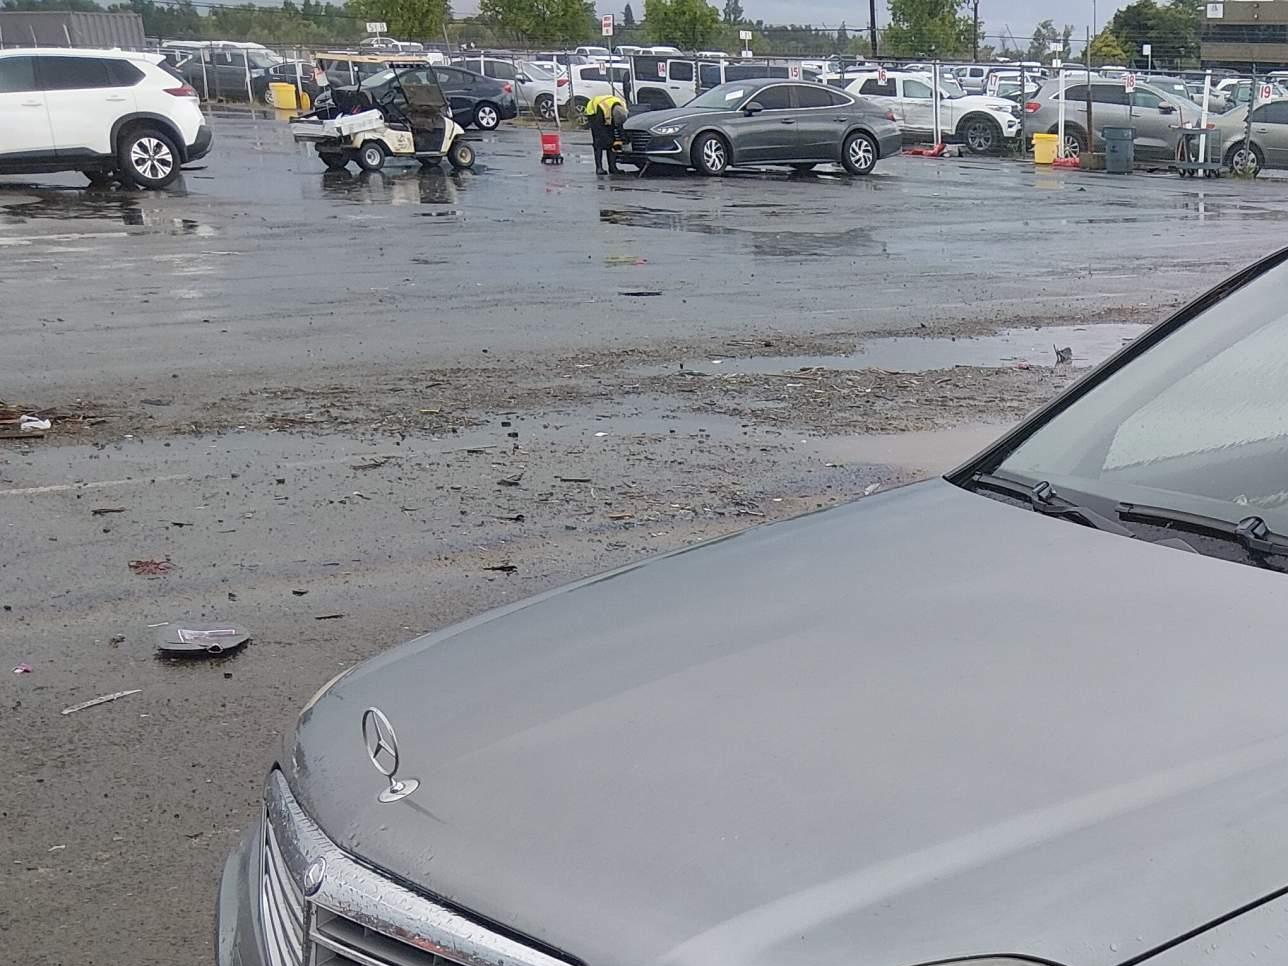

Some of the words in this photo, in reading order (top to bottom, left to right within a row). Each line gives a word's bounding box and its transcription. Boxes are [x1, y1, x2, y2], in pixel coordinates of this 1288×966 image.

[790, 66, 800, 77] 15
[878, 70, 887, 80] 16
[1126, 75, 1136, 88] 18
[1259, 86, 1271, 99] 19
